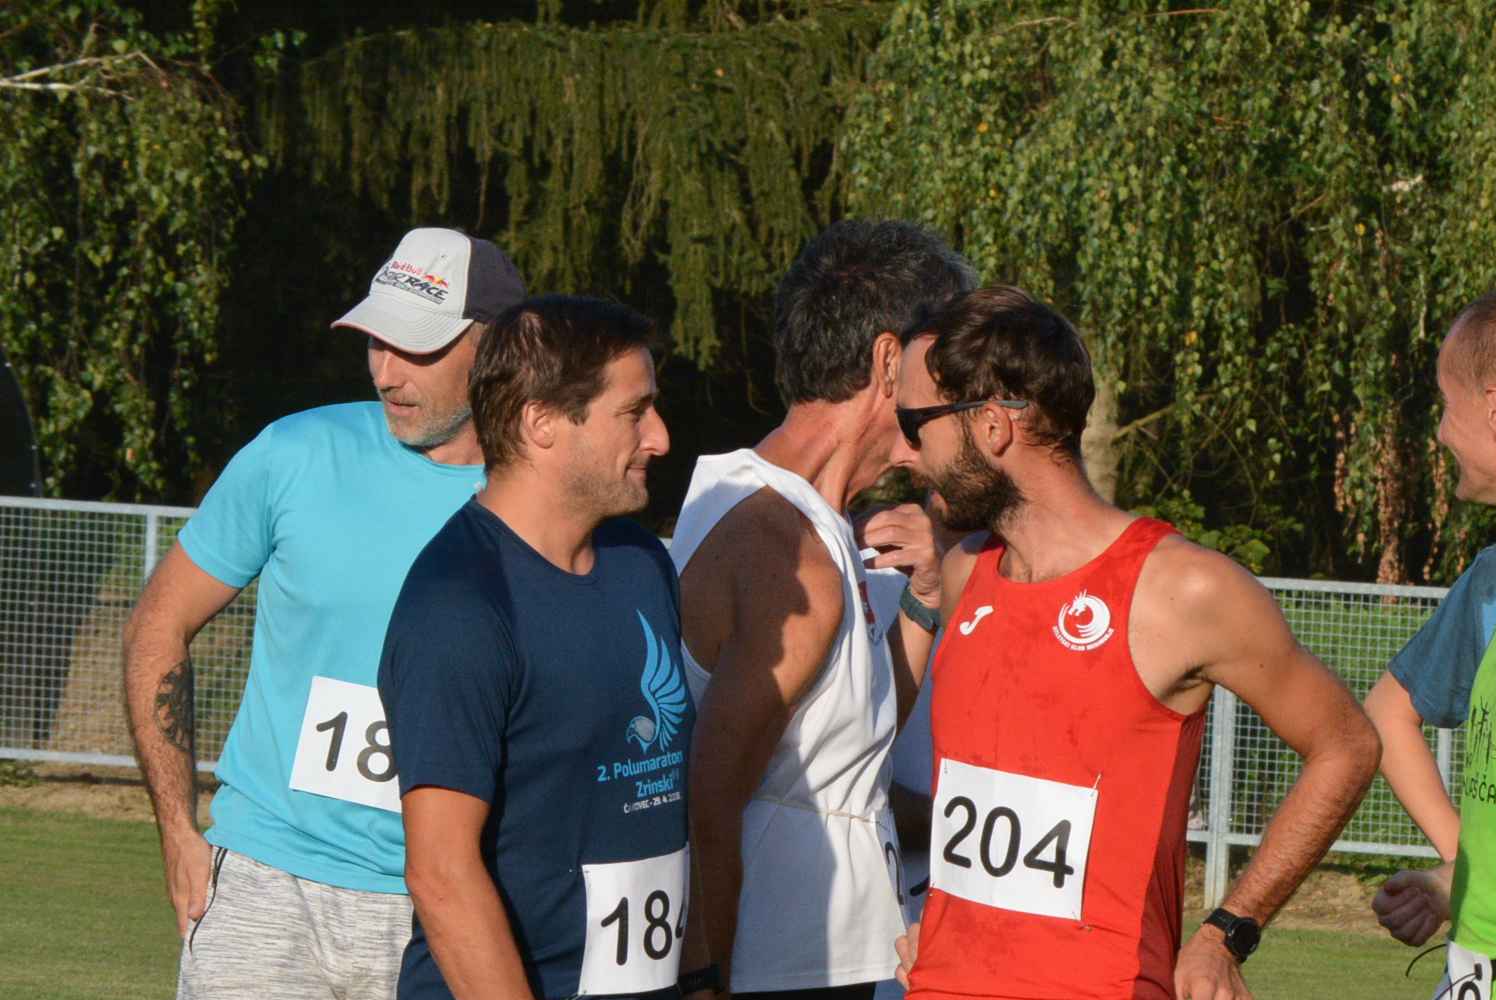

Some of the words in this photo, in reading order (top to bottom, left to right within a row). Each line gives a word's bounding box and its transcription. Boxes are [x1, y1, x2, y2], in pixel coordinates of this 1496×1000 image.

[405, 275, 448, 300] RACE
[597, 765, 611, 781] 2.
[613, 751, 684, 779] Polumaraton
[635, 774, 674, 798] Zrinski
[943, 796, 1074, 888] 204
